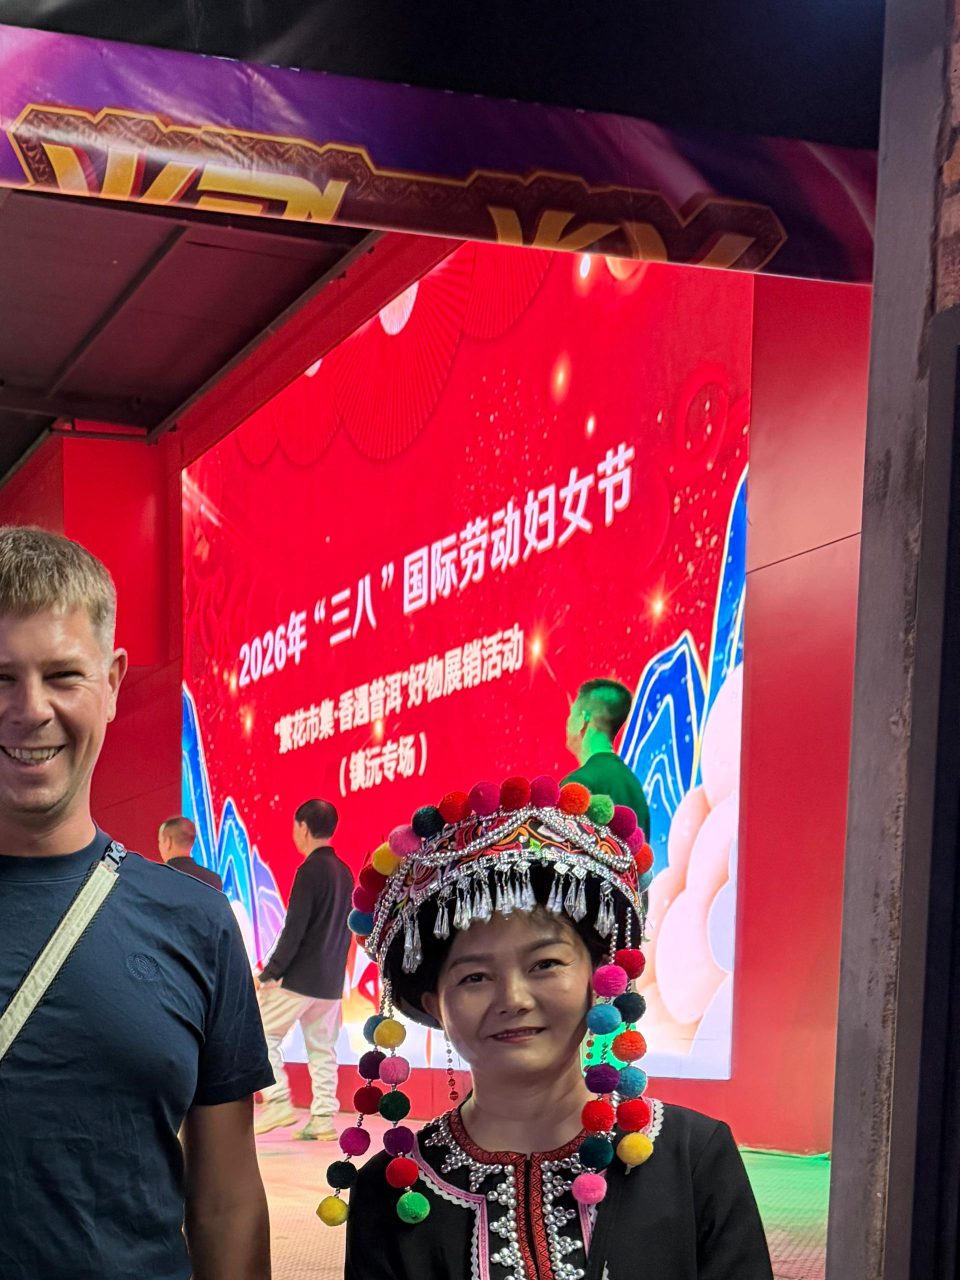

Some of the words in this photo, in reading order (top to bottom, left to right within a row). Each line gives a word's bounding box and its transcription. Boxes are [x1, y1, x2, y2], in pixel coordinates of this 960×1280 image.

[238, 441, 635, 688] 2026年“三八”国际劳动妇女节
